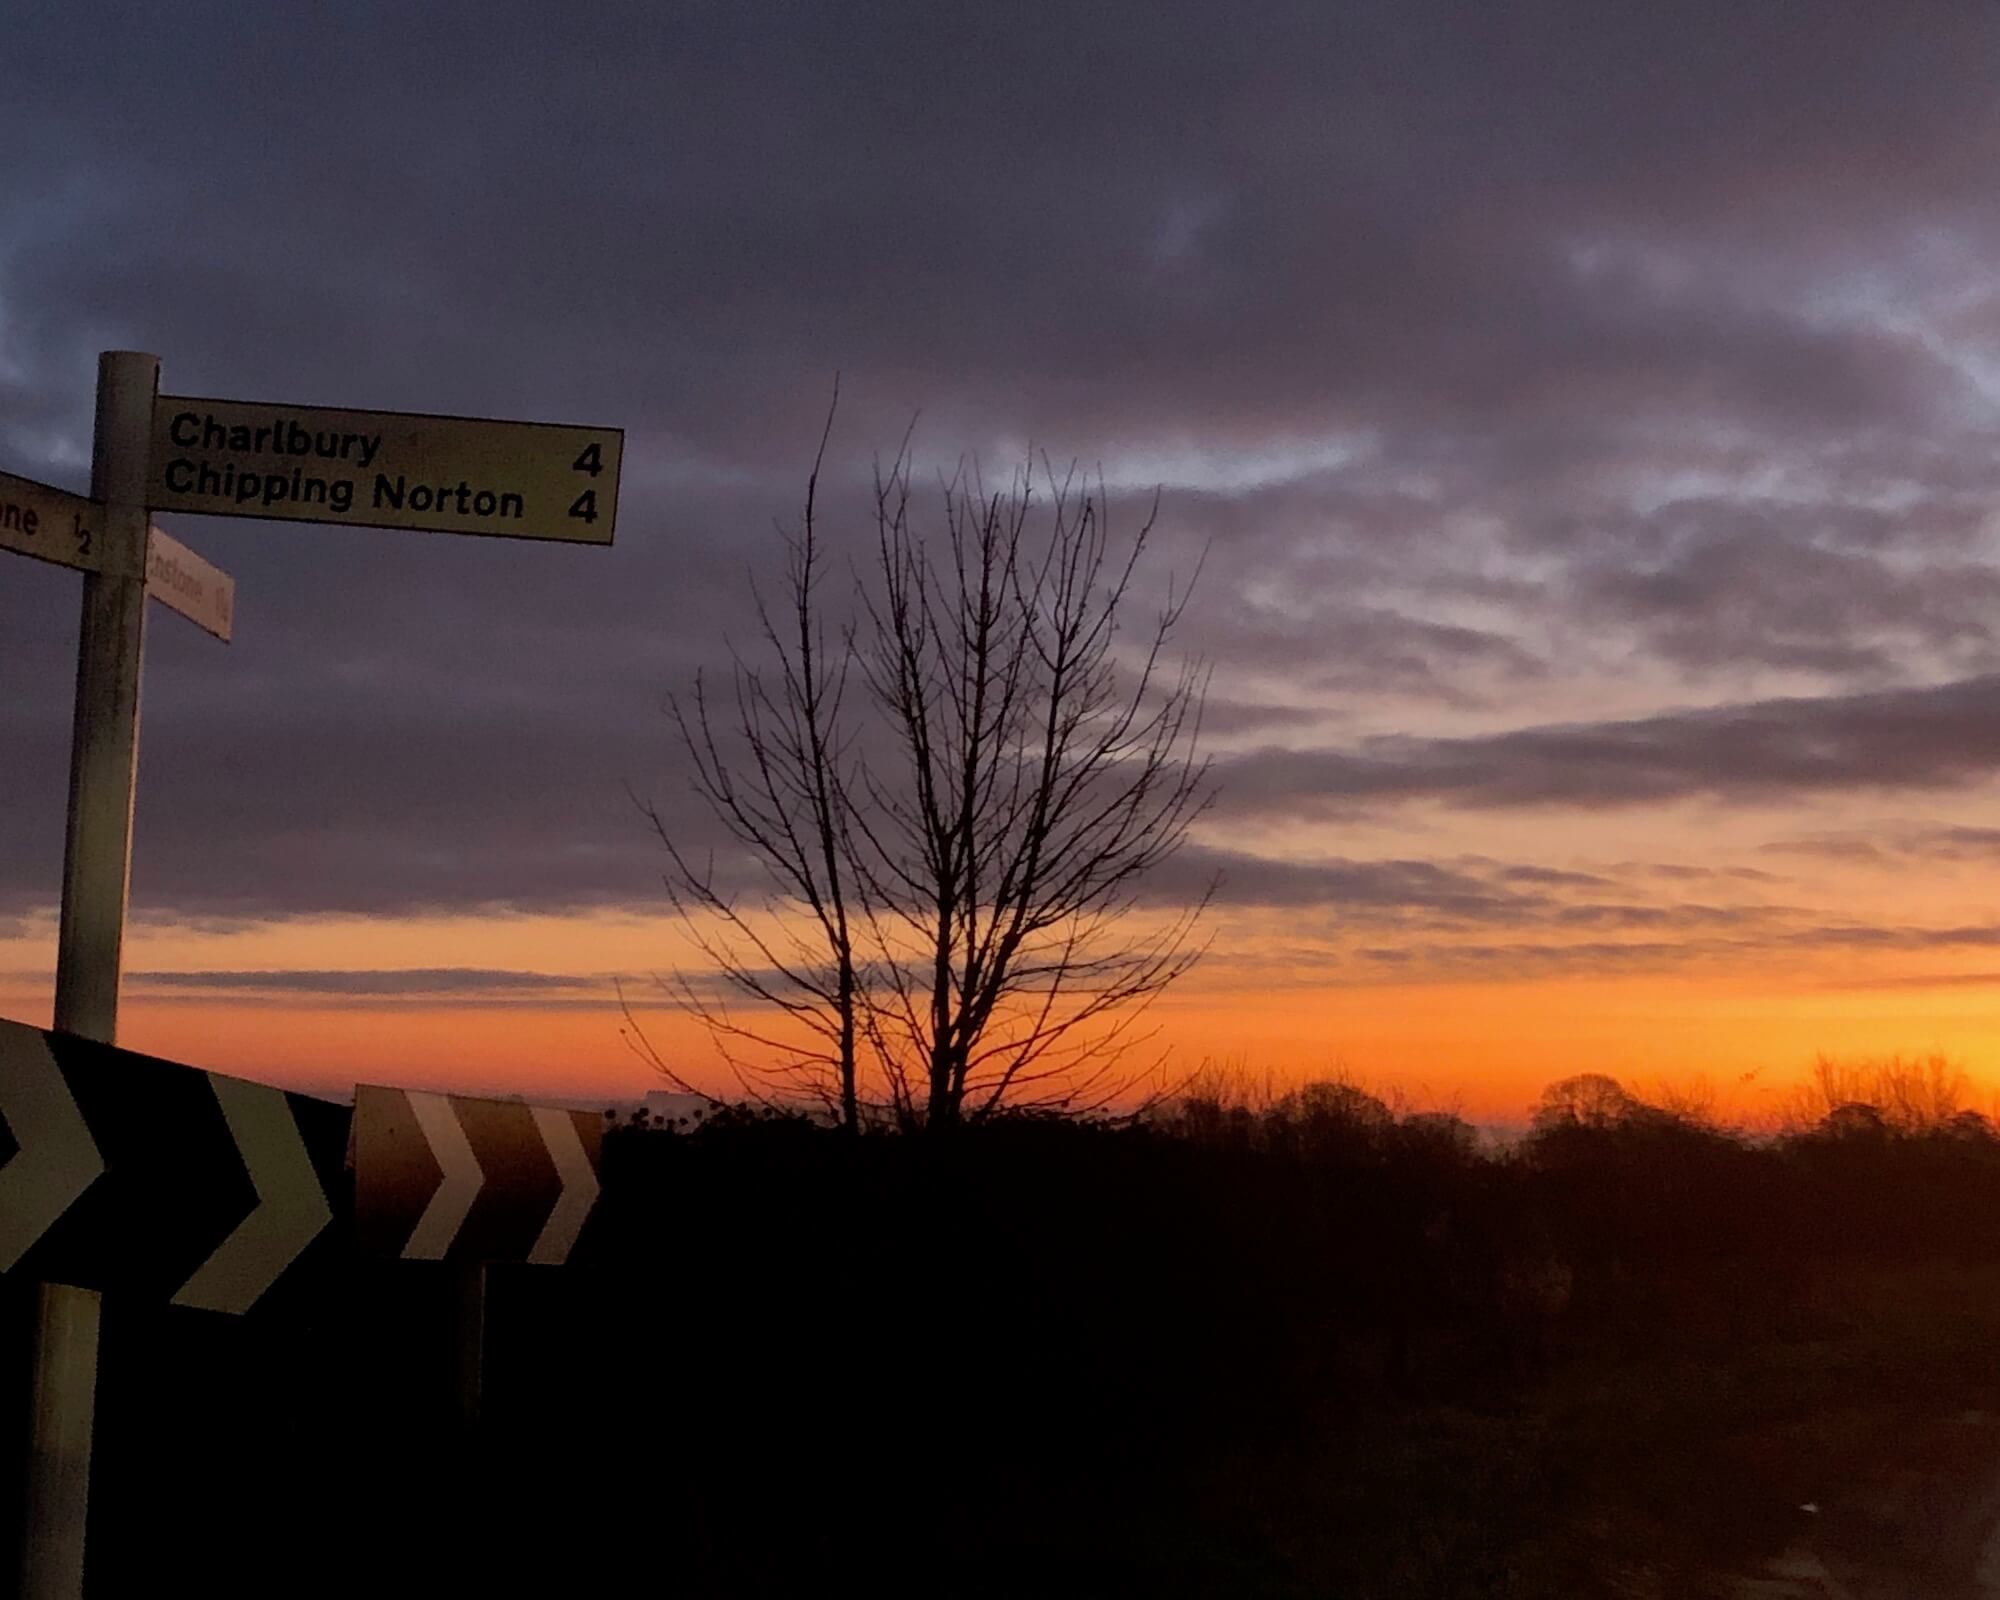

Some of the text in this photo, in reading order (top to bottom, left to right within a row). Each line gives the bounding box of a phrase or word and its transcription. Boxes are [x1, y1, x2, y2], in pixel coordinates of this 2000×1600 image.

[170, 412, 604, 477] Charlbury 4
[0, 501, 38, 536] ne
[165, 458, 598, 523] Chipping Norton 4
